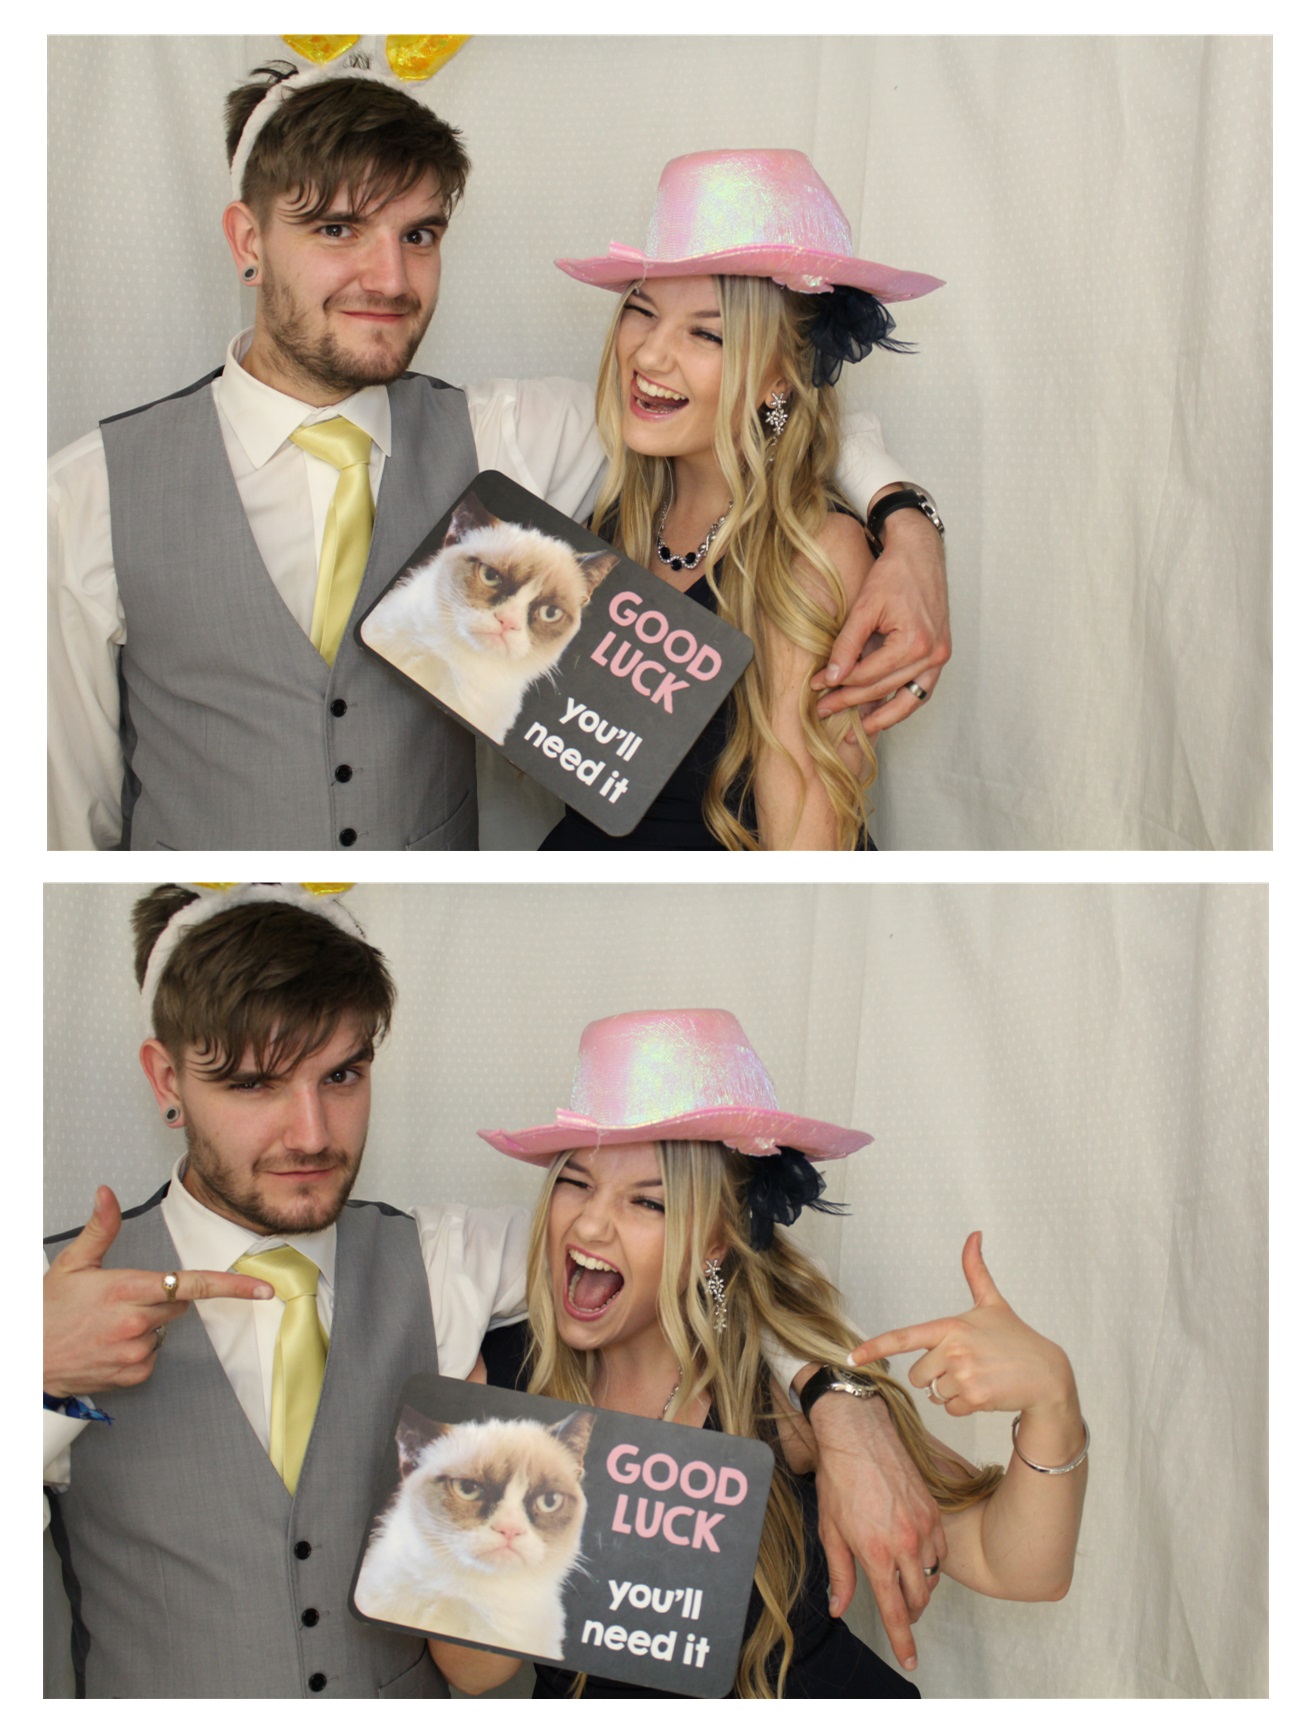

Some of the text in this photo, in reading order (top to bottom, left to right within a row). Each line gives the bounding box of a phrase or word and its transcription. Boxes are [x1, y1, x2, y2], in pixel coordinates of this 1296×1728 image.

[609, 591, 722, 681] GOOD
[590, 632, 690, 714] LUCK
[559, 697, 643, 762] you'll
[524, 722, 628, 804] need it
[606, 1444, 748, 1506] GOOD
[611, 1494, 725, 1553] LUCK
[608, 1580, 703, 1620] you'll
[581, 1620, 710, 1668] need it
